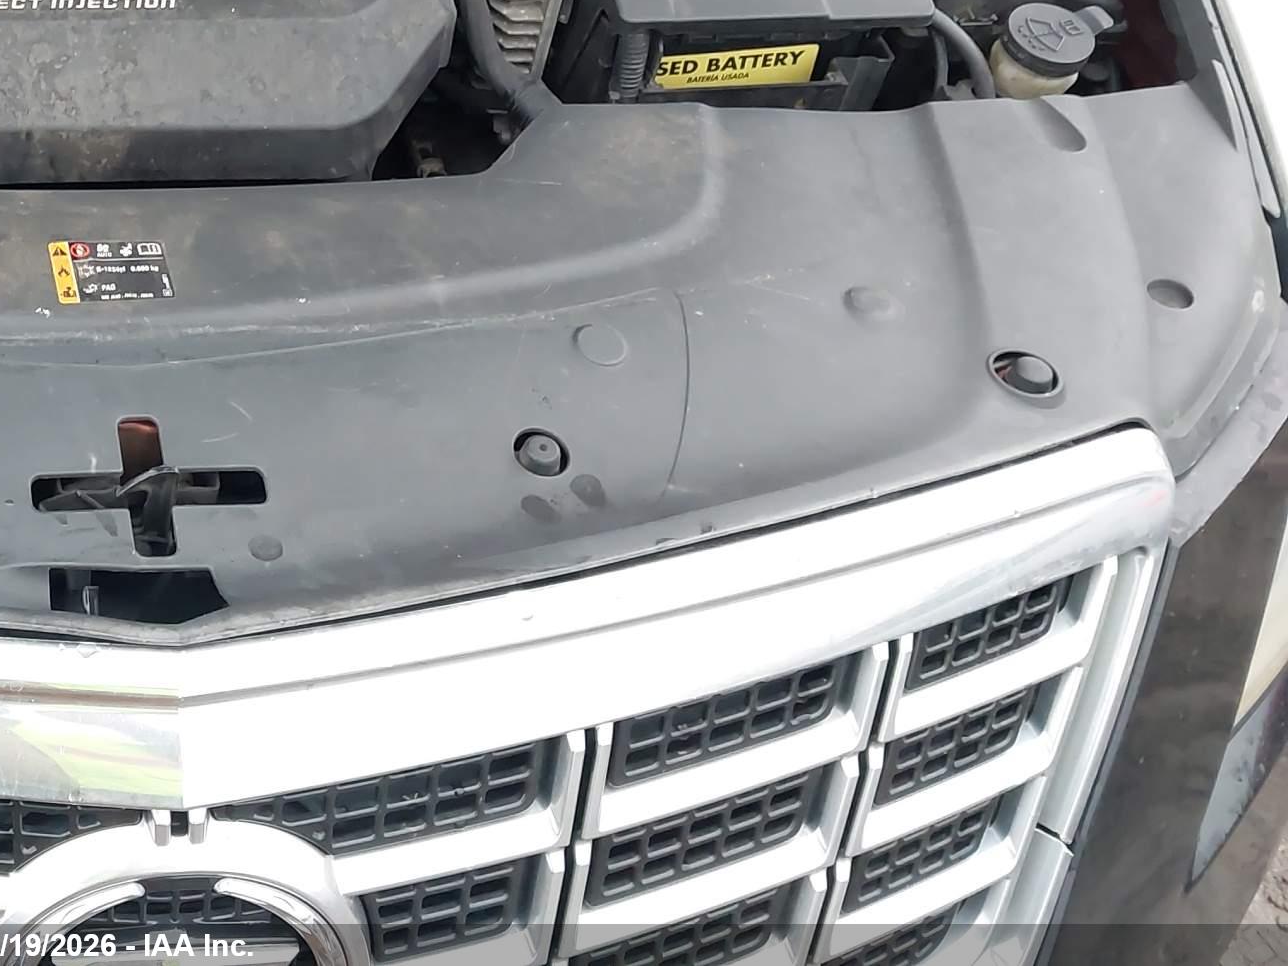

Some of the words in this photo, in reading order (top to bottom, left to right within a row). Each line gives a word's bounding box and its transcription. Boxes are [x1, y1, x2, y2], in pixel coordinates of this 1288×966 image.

[656, 58, 699, 76] SED
[707, 50, 805, 73] BATTERY
[101, 283, 116, 292] PAG
